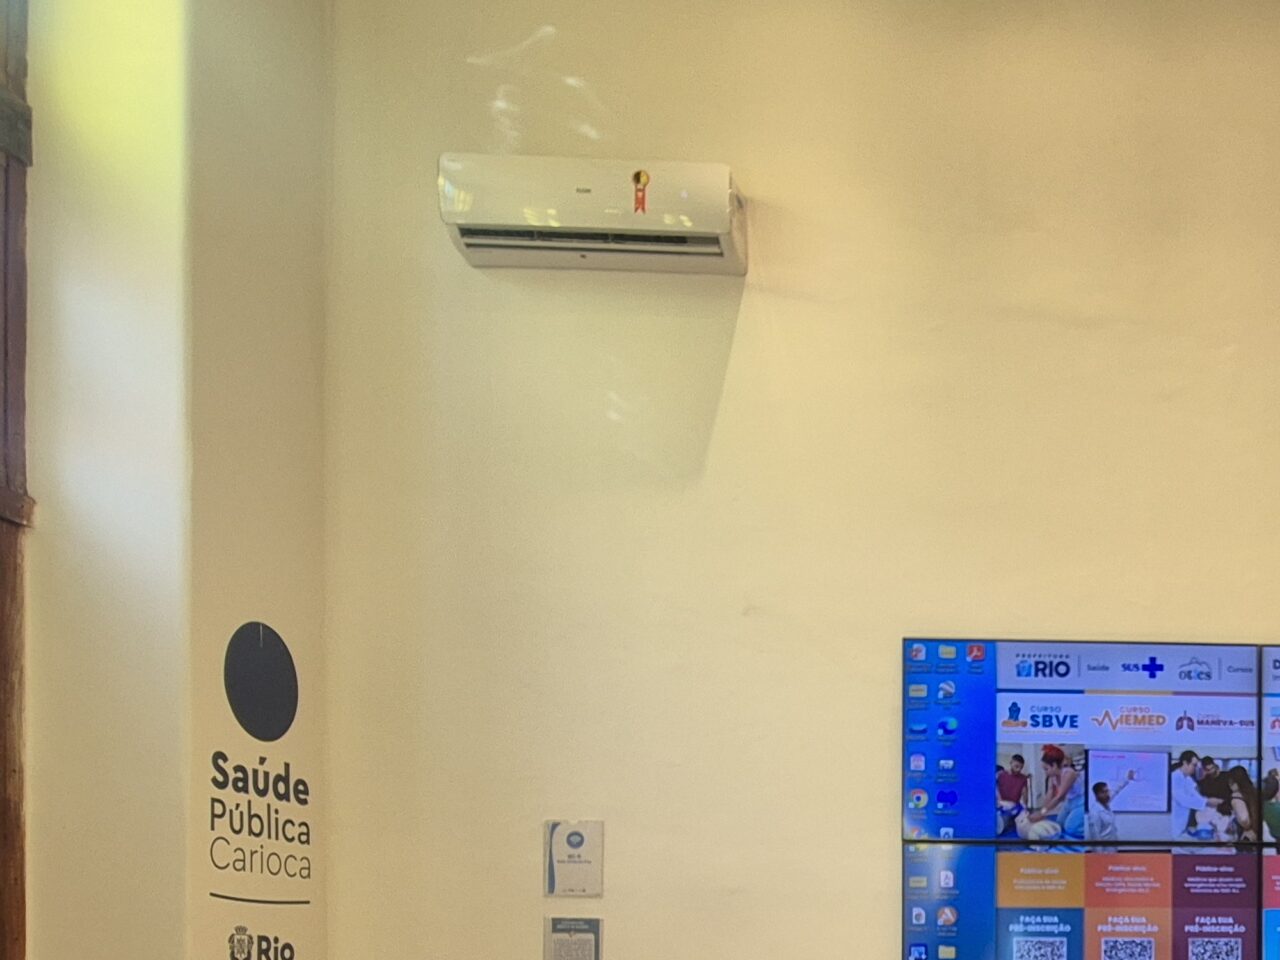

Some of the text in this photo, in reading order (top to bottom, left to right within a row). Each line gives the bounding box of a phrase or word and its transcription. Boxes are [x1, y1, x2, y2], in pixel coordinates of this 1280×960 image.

[1034, 660, 1071, 678] RIO
[1121, 663, 1140, 672] SUS
[1030, 705, 1061, 713] CURSO
[1030, 714, 1079, 728] SBVE
[211, 751, 310, 806] Saúde
[210, 797, 310, 845] Pública
[210, 836, 311, 879] Carioca
[1019, 915, 1042, 924] FAÇA
[1108, 915, 1130, 925] FAÇA
[1195, 916, 1217, 925] FAÇA
